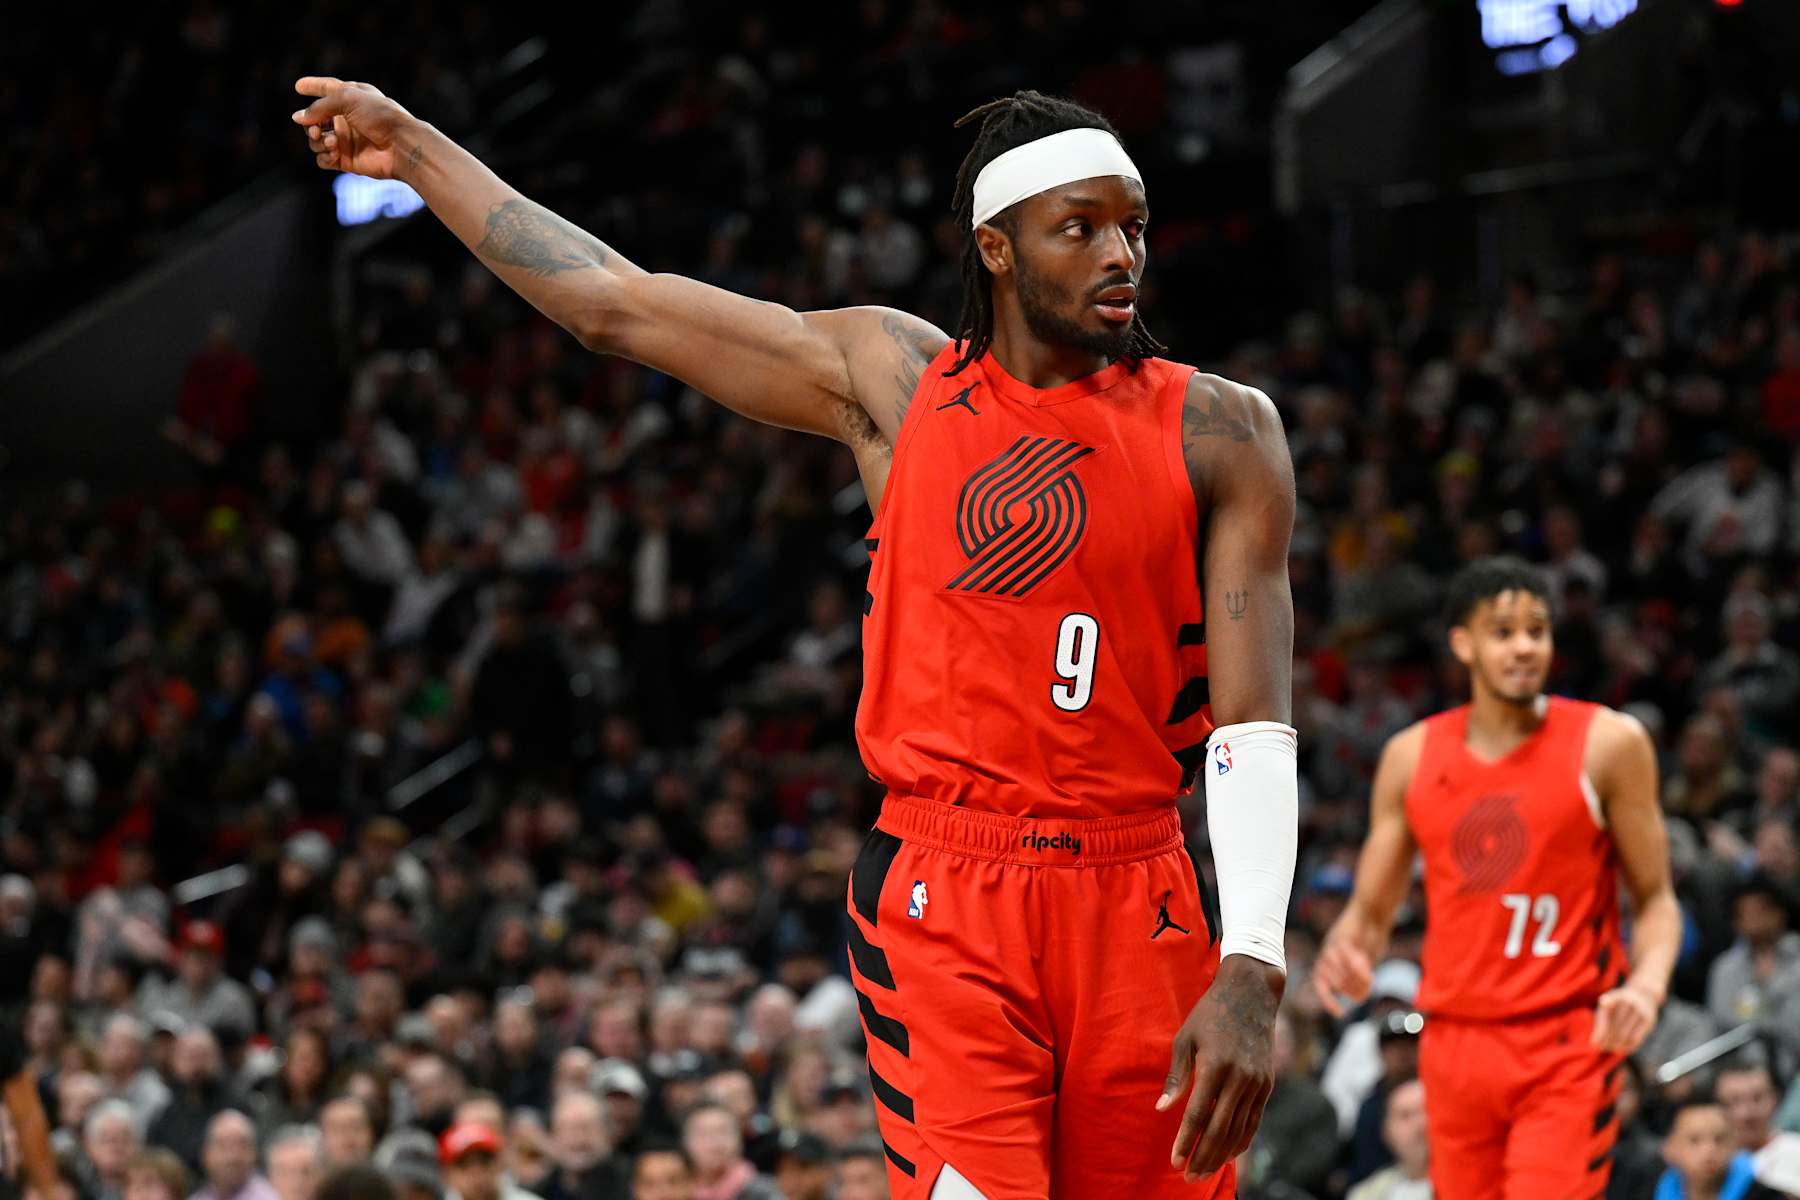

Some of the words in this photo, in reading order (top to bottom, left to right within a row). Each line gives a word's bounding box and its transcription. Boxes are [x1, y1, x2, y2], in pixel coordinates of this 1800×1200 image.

[1051, 613, 1100, 712] 9
[1022, 831, 1081, 855] ripcity
[1502, 894, 1562, 958] 72
